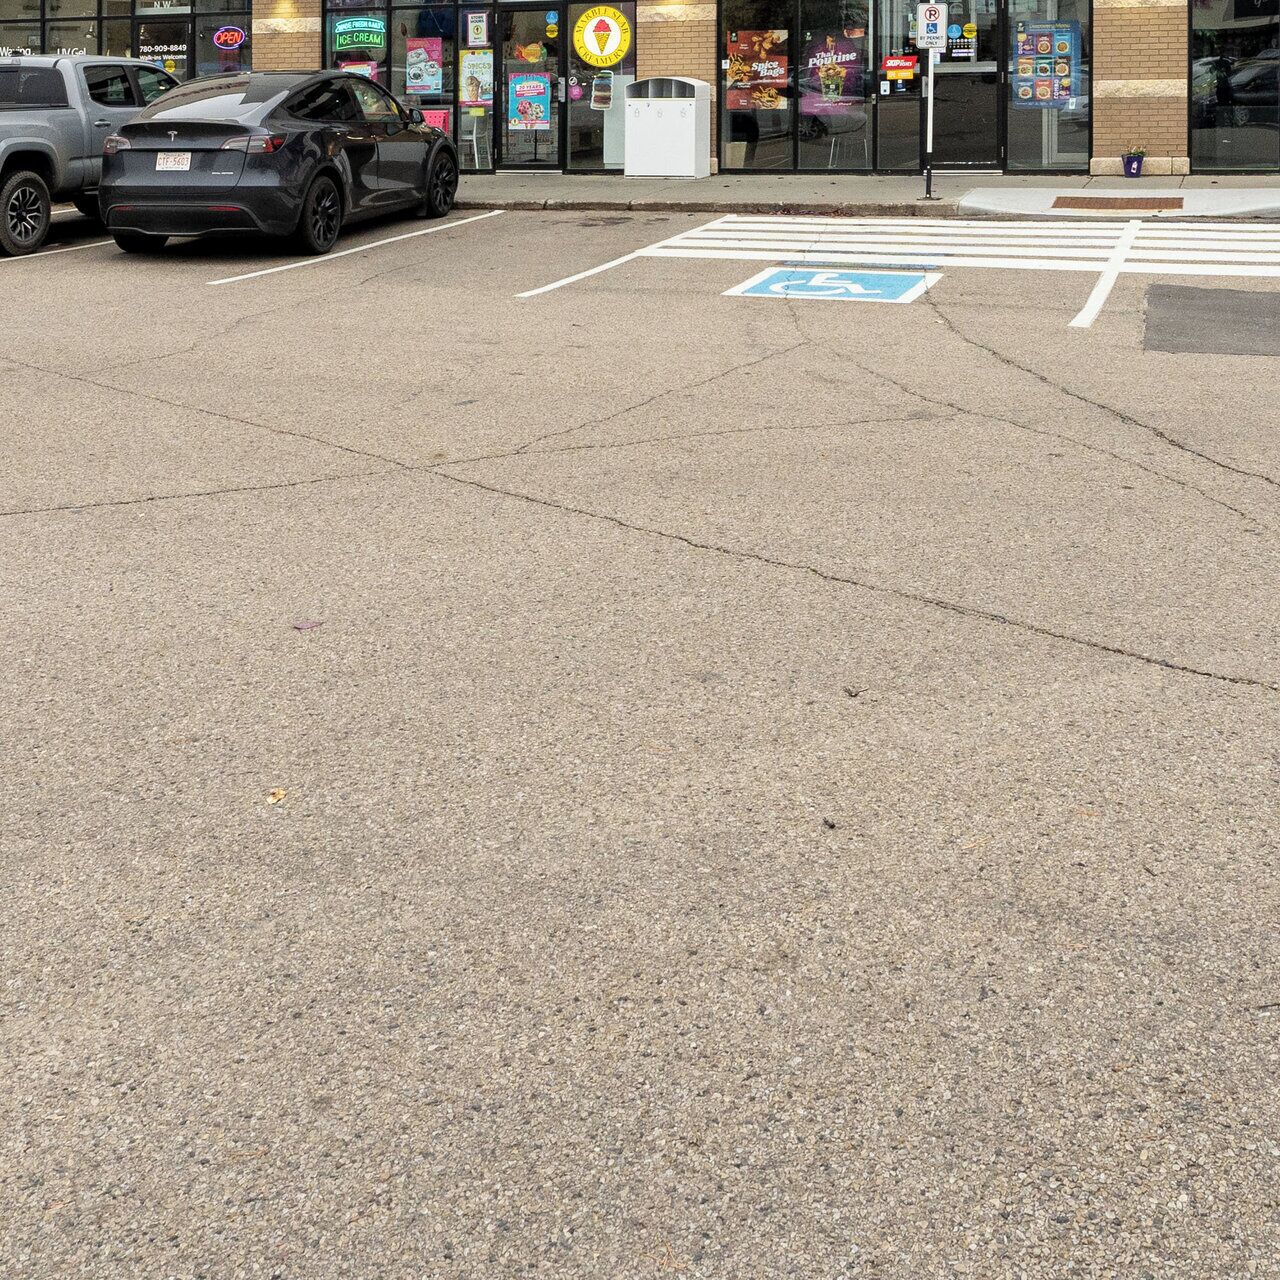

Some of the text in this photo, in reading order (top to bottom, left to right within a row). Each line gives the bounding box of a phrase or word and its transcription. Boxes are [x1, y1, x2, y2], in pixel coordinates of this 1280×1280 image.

[217, 31, 242, 44] OPEN
[339, 32, 381, 45] ICE CREAM
[71, 47, 87, 56] Gel
[751, 60, 779, 72] Spice
[808, 52, 857, 68] Poutine
[760, 66, 785, 77] Bags
